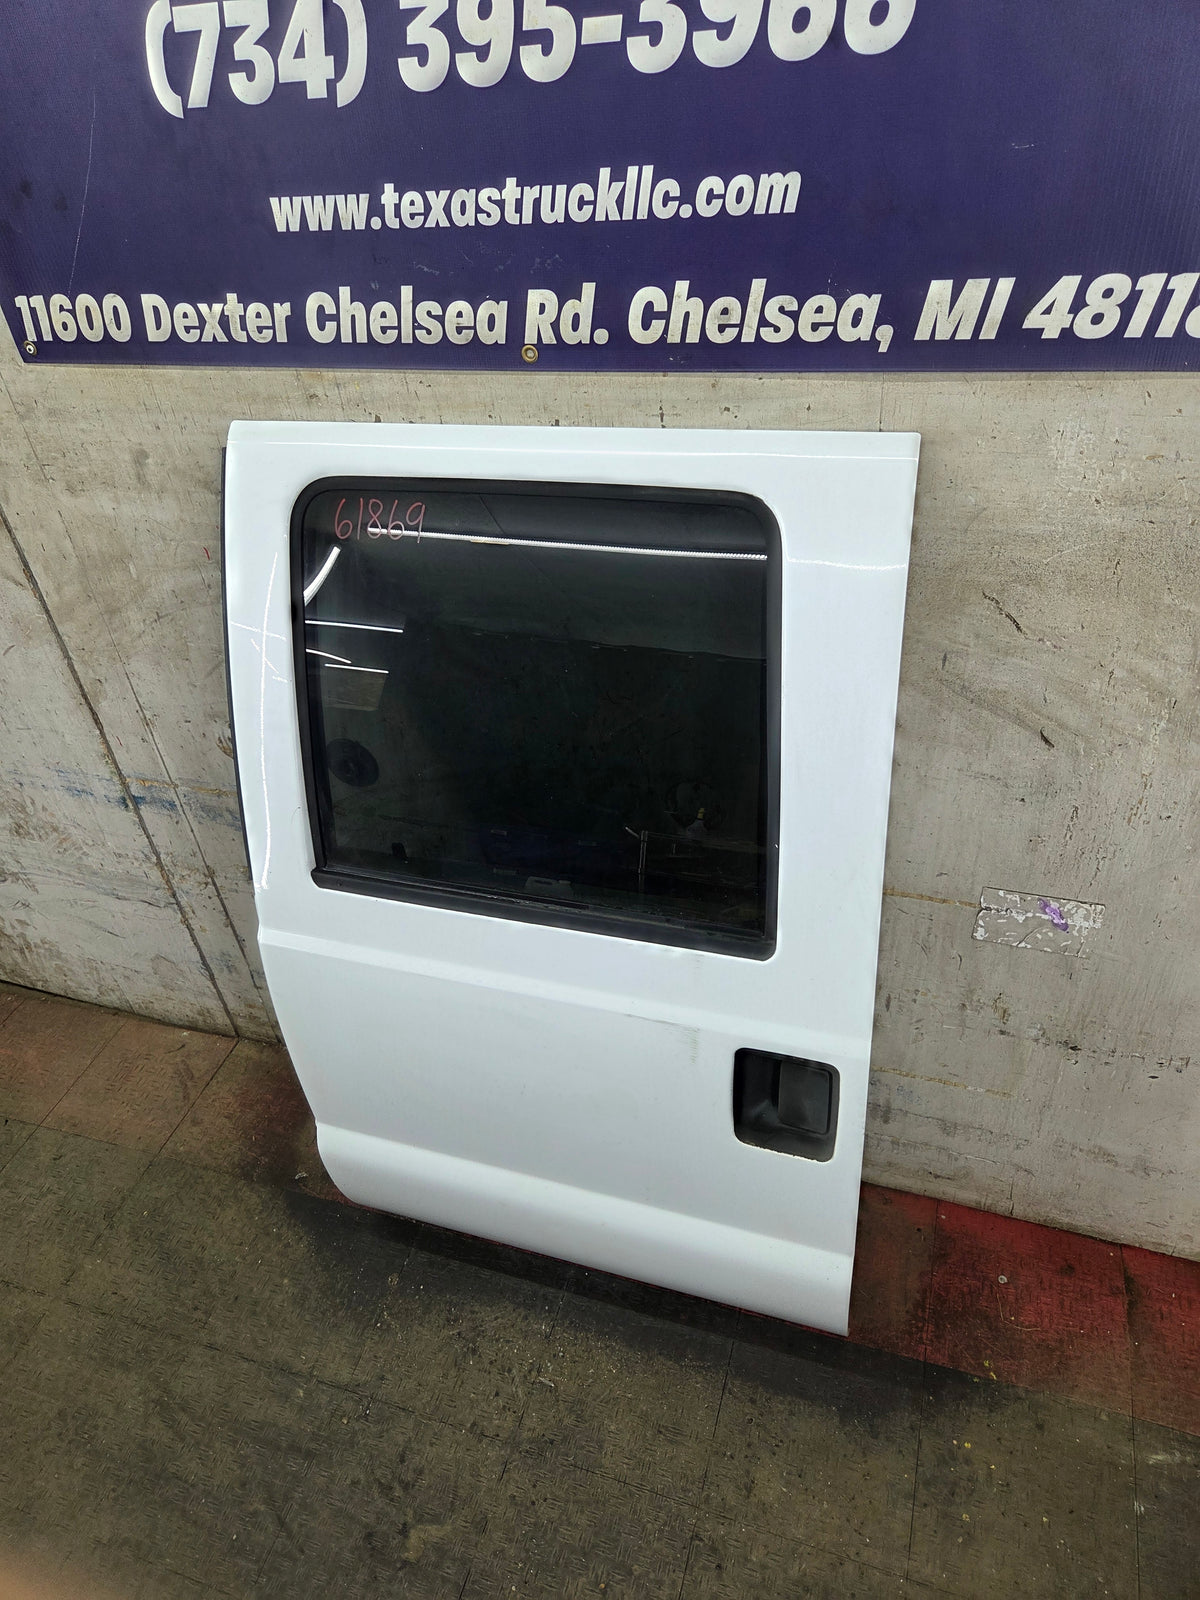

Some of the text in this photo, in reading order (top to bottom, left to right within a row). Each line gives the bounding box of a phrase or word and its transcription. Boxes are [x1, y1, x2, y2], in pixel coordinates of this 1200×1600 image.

[145, 0, 367, 118] (734)
[269, 164, 802, 233] www.texastruckllc.com
[15, 293, 131, 343] 11600
[141, 292, 292, 343] Dexter
[306, 285, 508, 345] Chelsea
[525, 281, 609, 345] Rd.
[628, 278, 894, 353] Chelsea,
[914, 276, 1016, 340] MI
[334, 497, 426, 544] 61869
